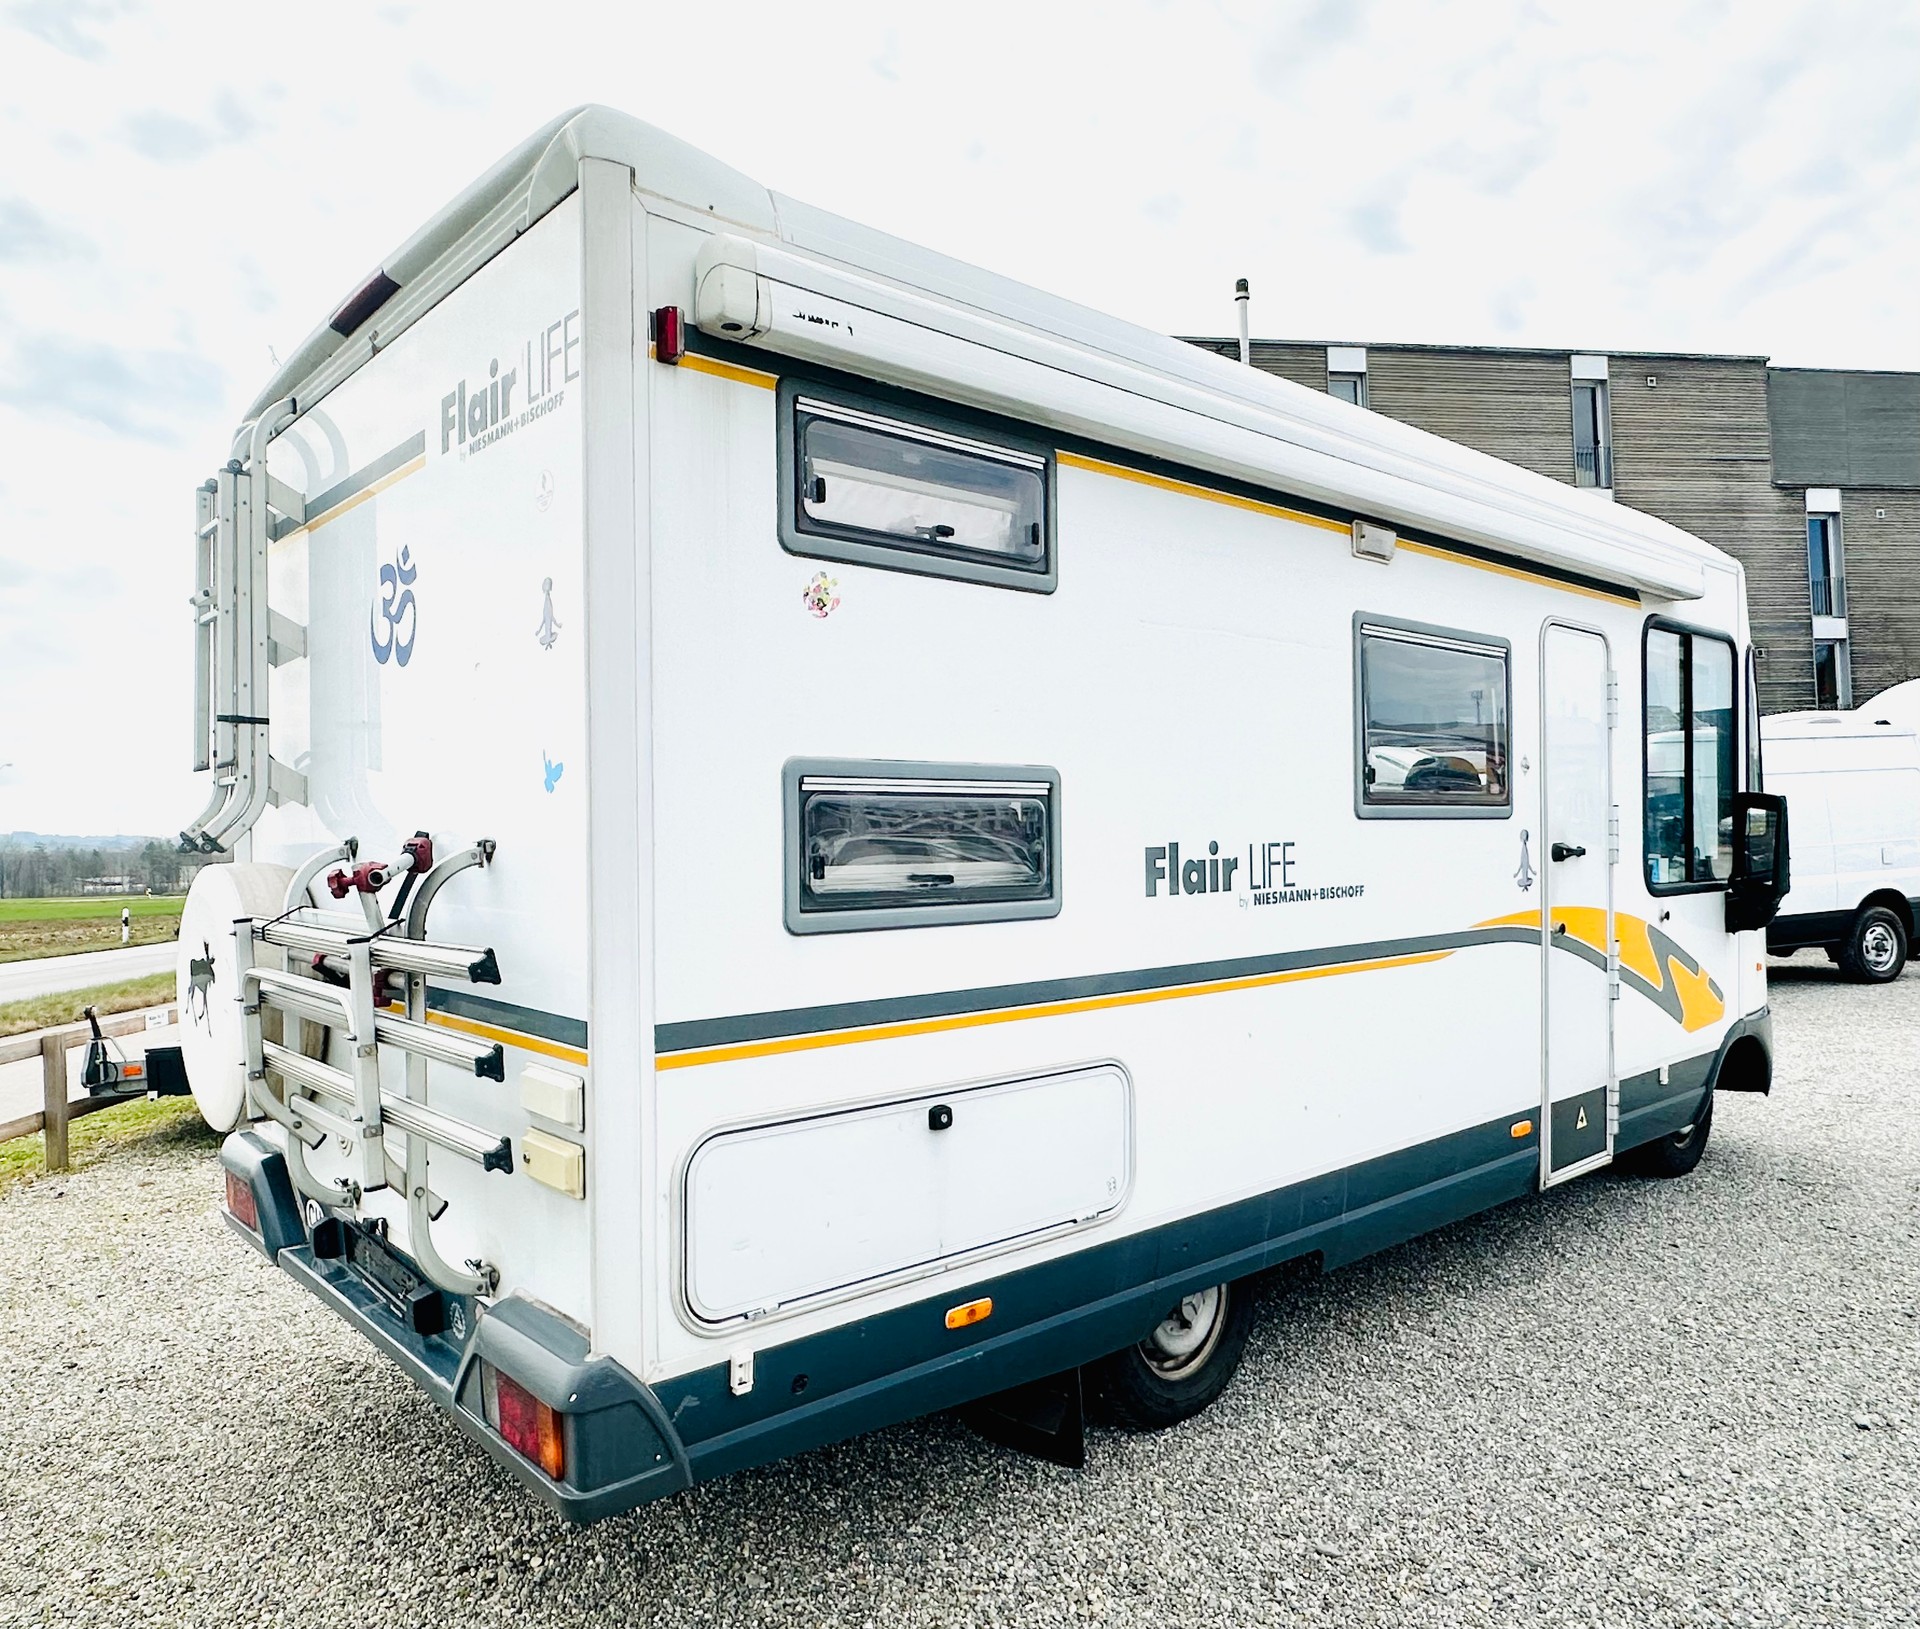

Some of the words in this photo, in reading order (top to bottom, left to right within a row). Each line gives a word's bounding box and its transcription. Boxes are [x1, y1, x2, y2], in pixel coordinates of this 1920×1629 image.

[441, 358, 516, 455] Flair
[527, 309, 579, 404] LIFE
[469, 390, 565, 456] NIESMANN+BISCHOFF
[1145, 840, 1238, 897] Flair
[1249, 842, 1296, 890] LIFE
[1238, 892, 1249, 910] by
[1253, 885, 1365, 906] NIESMANN+BISCHOFF
